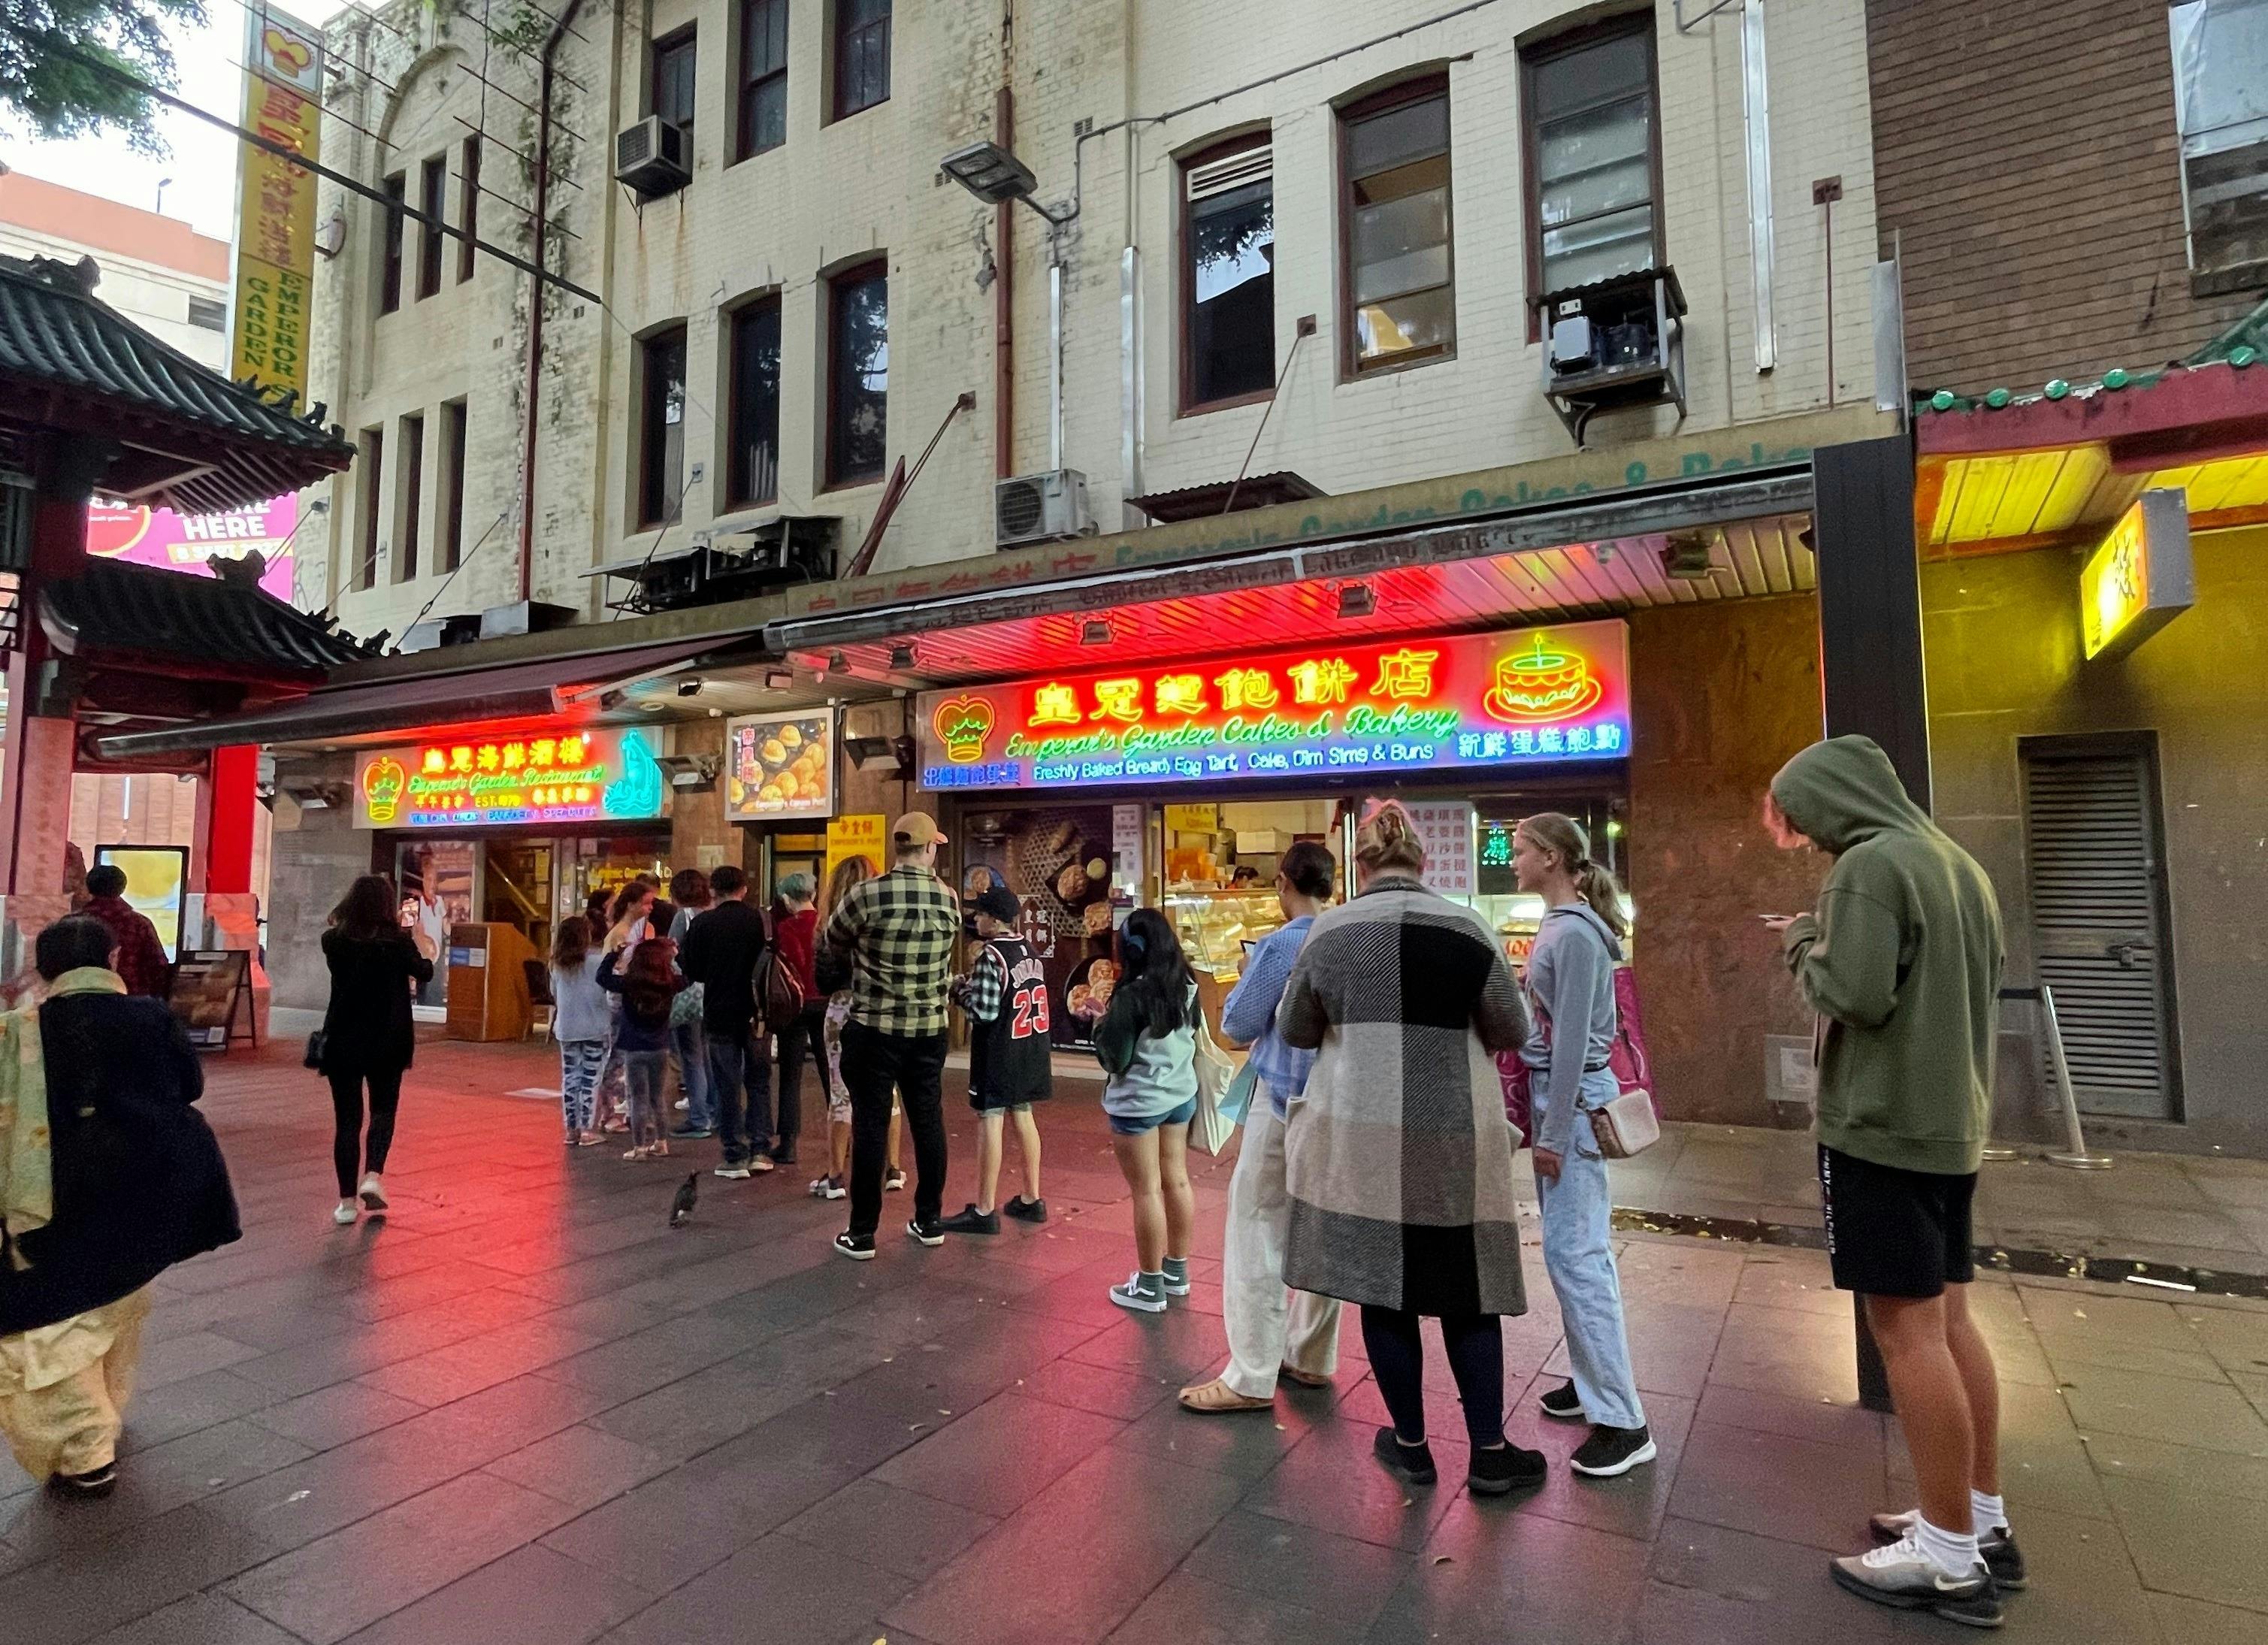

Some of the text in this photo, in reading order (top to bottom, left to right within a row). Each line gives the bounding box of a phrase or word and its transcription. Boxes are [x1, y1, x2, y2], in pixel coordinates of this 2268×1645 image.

[244, 277, 270, 367] GARDEN
[183, 516, 266, 540] HERE
[1004, 727, 1116, 762] Emperor's
[1120, 720, 1216, 759] Garden
[1221, 712, 1299, 744] Cakes
[1343, 703, 1461, 741] Bakery
[1033, 764, 1079, 781] Freshly
[1081, 761, 1123, 778] Baked
[1175, 756, 1202, 776] Egg
[1293, 747, 1323, 765] Dim
[1371, 745, 1387, 761] &
[1390, 743, 1434, 761] Buns
[1011, 984, 1050, 1039] 23
